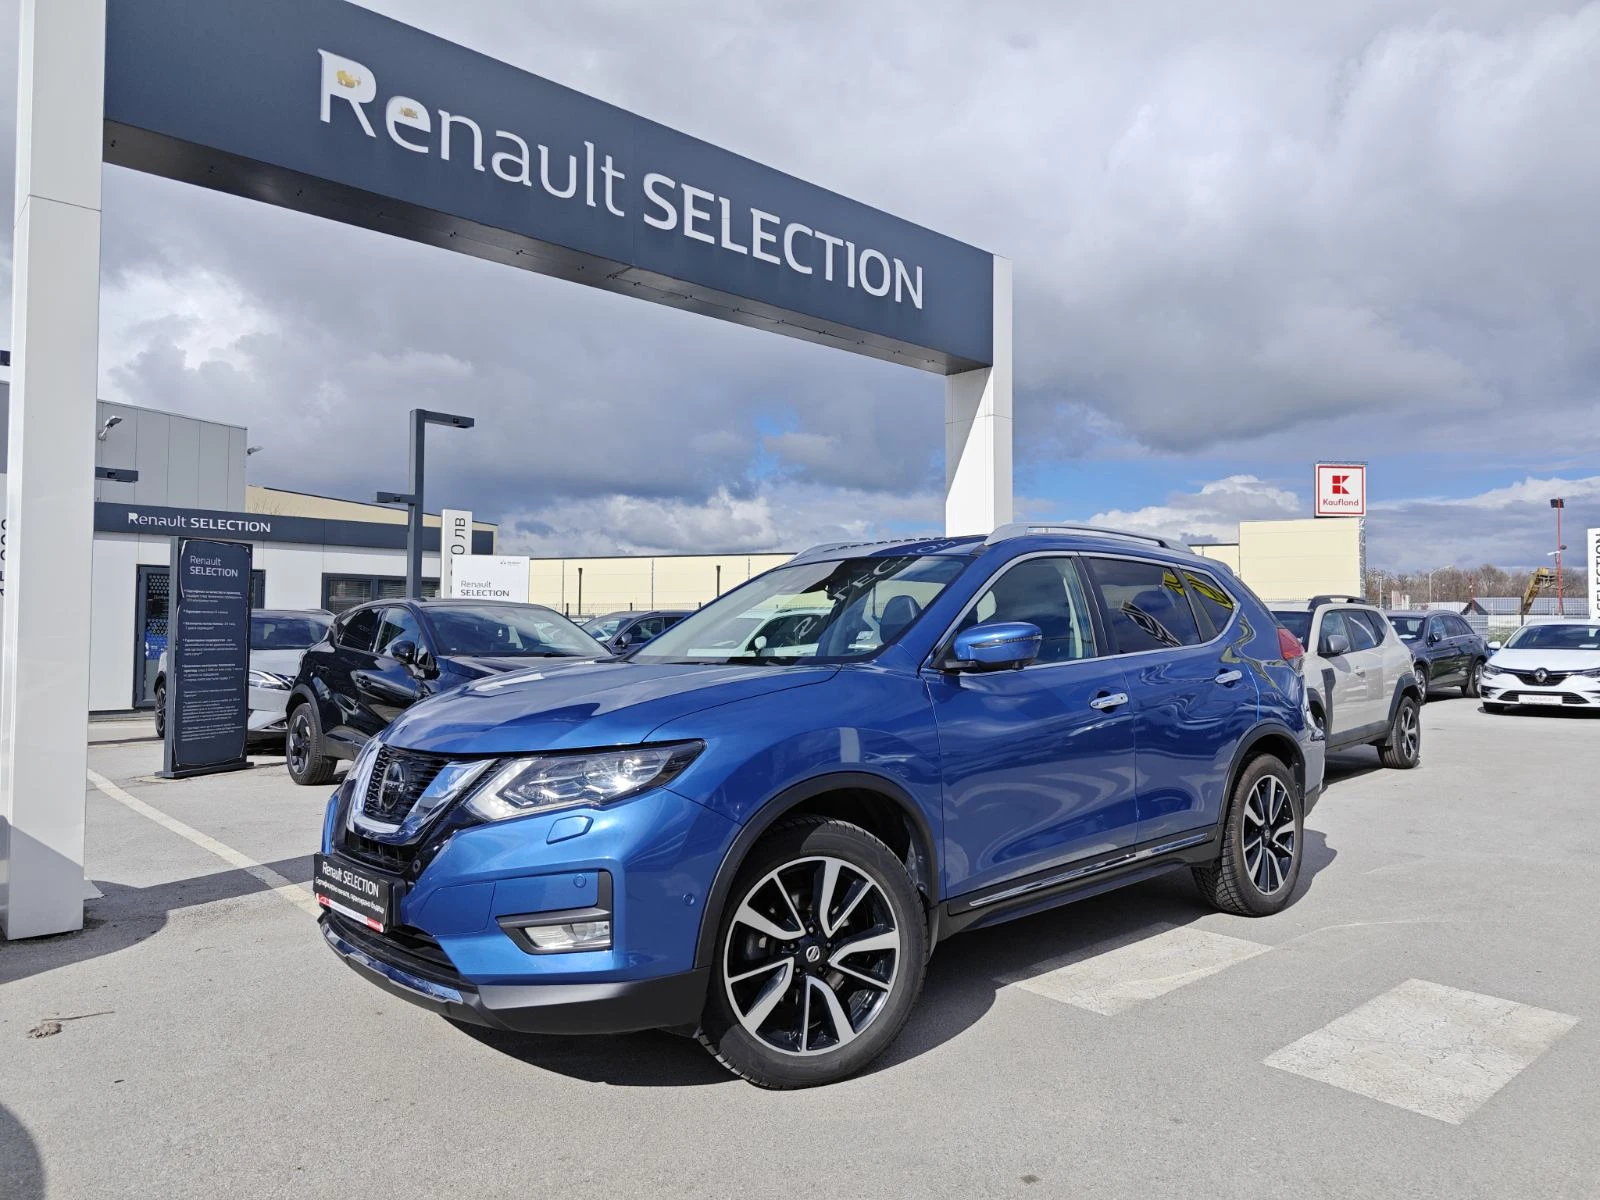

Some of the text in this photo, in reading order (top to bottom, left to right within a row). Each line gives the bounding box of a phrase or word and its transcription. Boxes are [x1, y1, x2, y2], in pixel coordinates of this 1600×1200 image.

[317, 48, 924, 310] Renault SELECTION
[1322, 498, 1359, 506] Kaufland
[128, 512, 271, 533] Renault SELECTION
[190, 555, 222, 566] Renault
[189, 566, 239, 577] SELECTION
[460, 580, 492, 588] Renault
[322, 861, 379, 898] Renault SELECTION
